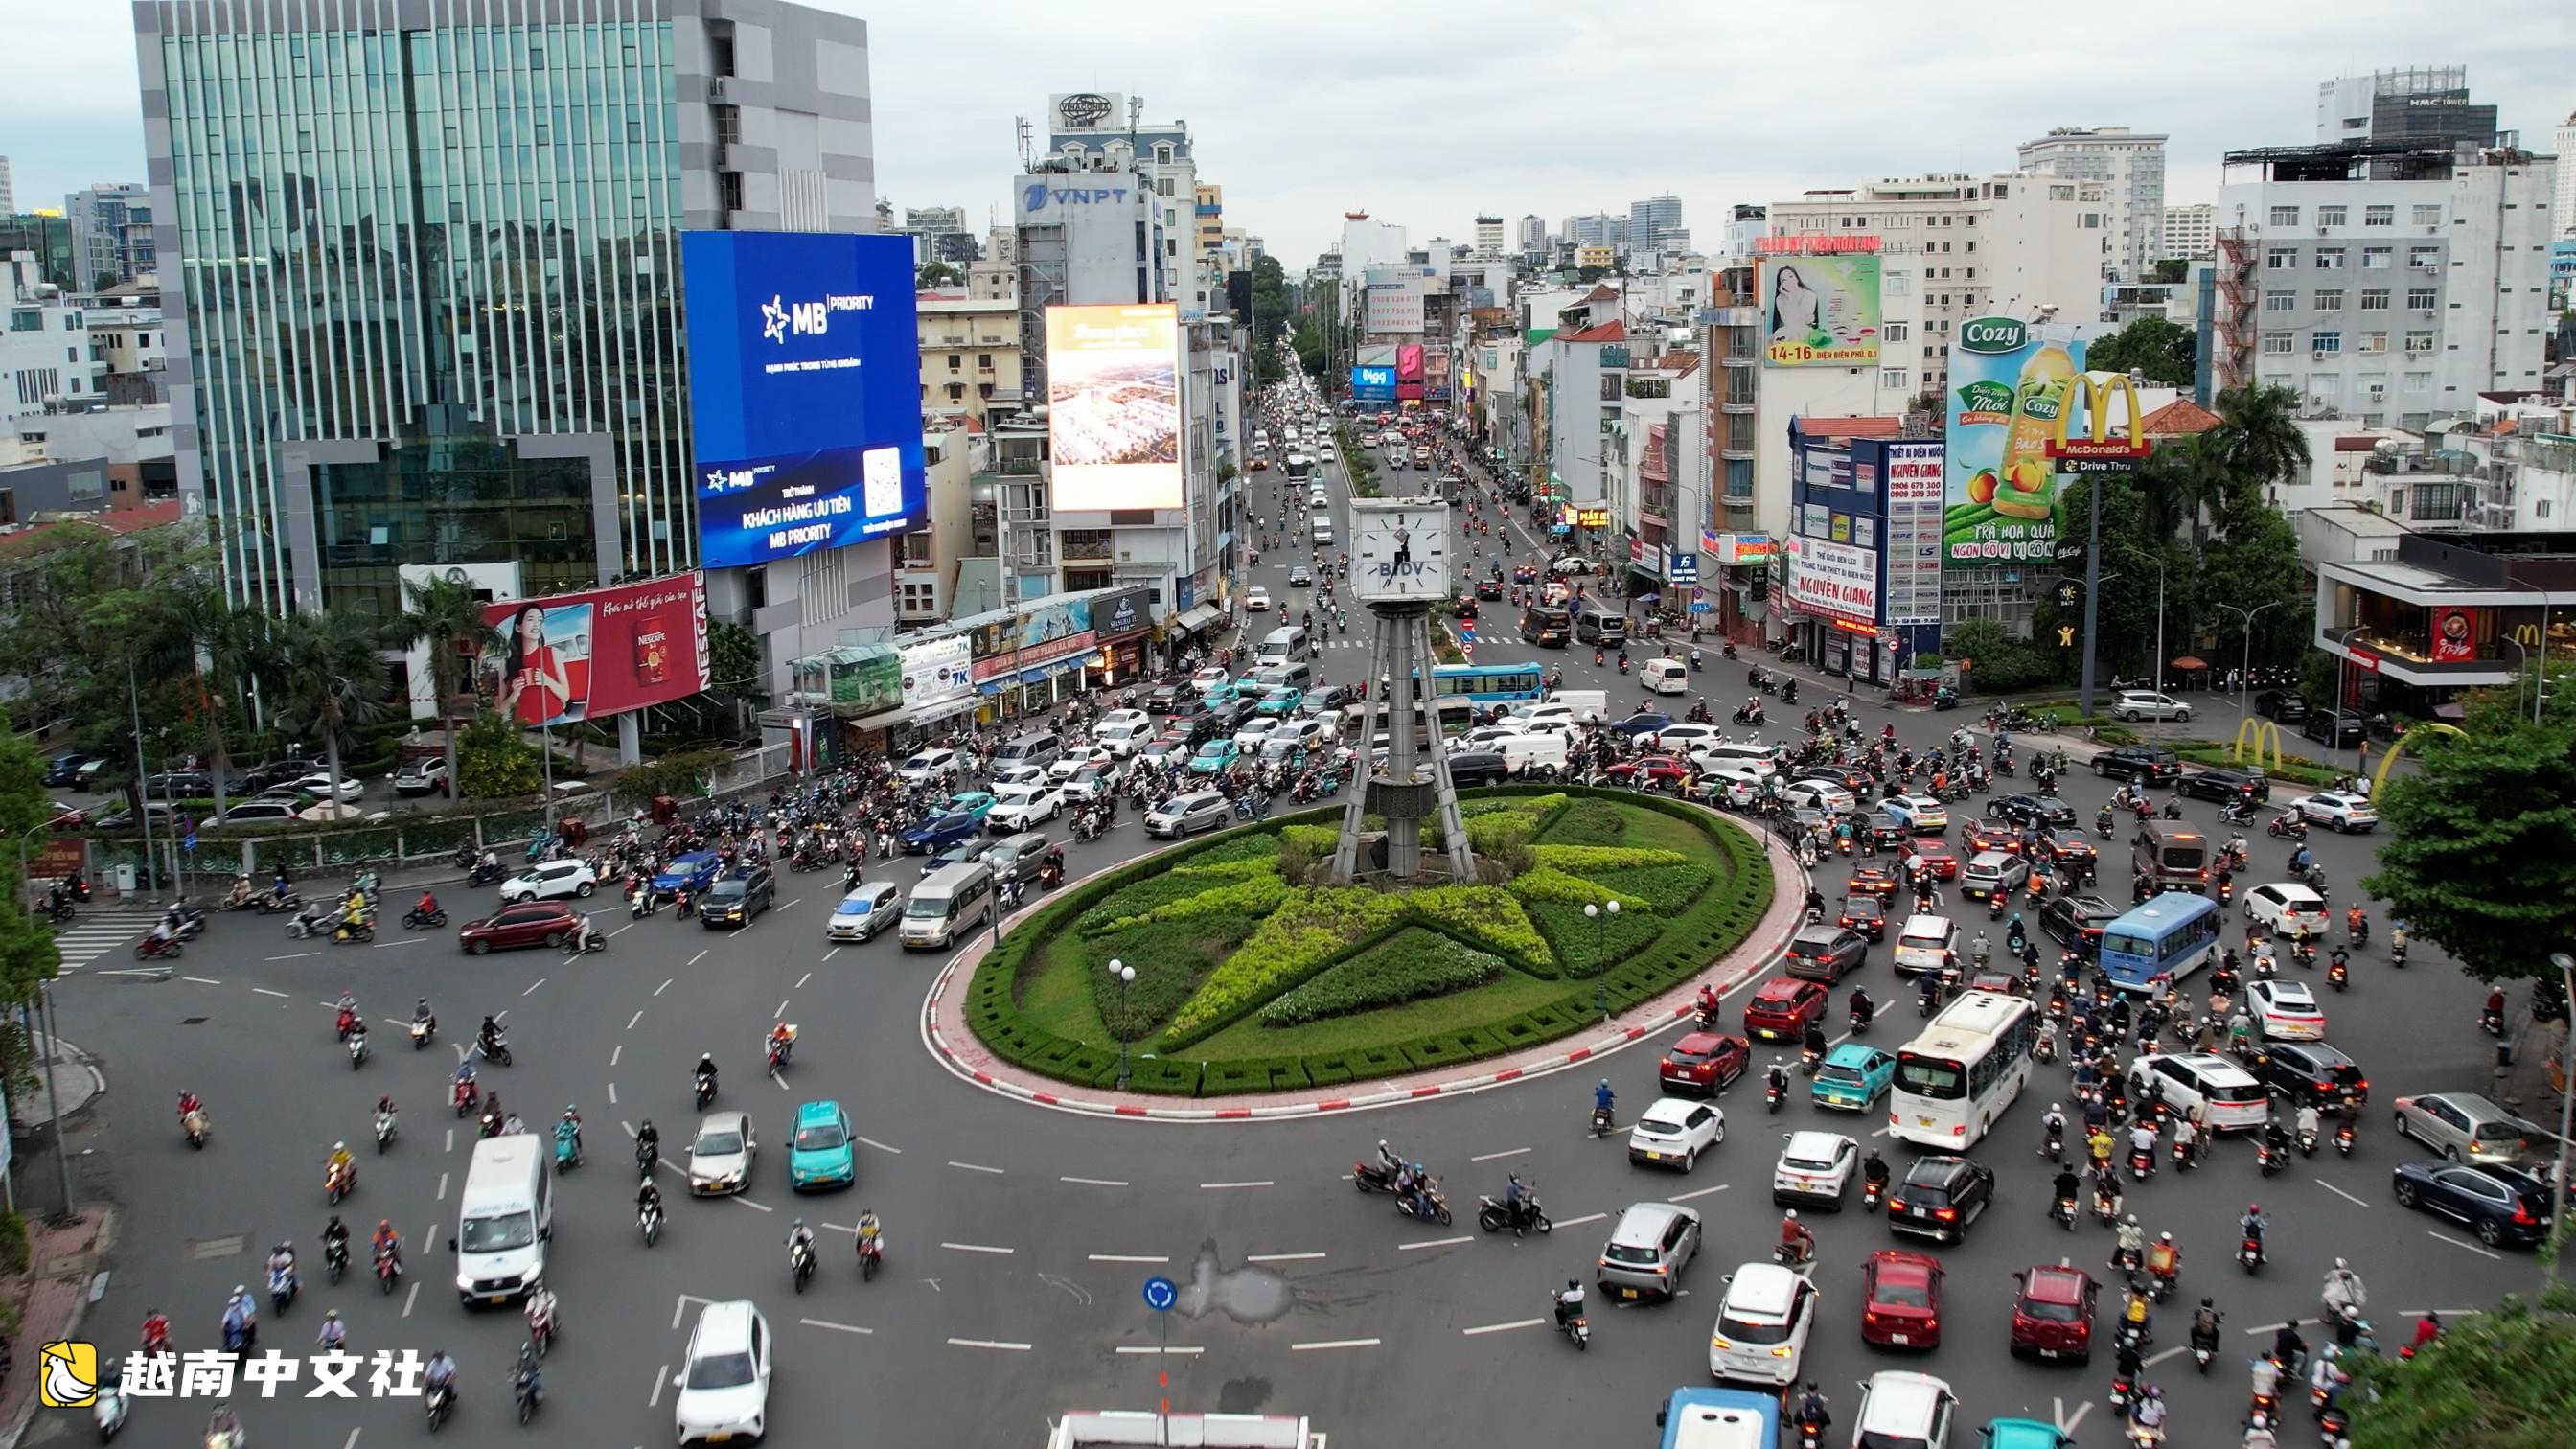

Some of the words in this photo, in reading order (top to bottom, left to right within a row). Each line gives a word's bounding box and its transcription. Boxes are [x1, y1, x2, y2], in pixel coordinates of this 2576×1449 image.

[1061, 103, 1109, 112] VINACONEX
[1054, 189, 1127, 204] VNPT
[793, 302, 828, 335] MB
[830, 295, 874, 311] PRIORITY
[1967, 324, 2019, 346] Cozy
[1771, 346, 1812, 360] 14-16
[2025, 399, 2059, 417] Cozy
[2066, 445, 2131, 454] McDonald's
[1920, 463, 1942, 478] GIANG
[2080, 461, 2107, 471] Drive
[2110, 461, 2131, 470] Thru
[729, 470, 754, 487] MB
[743, 508, 782, 529] KHÁCH
[782, 504, 813, 522] HÀNG
[830, 495, 851, 514] TIÊN
[770, 533, 786, 549] MB
[788, 523, 832, 546] PRIORITY
[1974, 523, 1996, 539] TRÀ
[2001, 525, 2024, 539] HOA
[2030, 518, 2055, 538] QUẢ
[1919, 547, 1936, 556] LS
[1953, 544, 1979, 557] NGON
[1380, 562, 1425, 576] BIDV
[1842, 586, 1873, 607] GIANG
[952, 669, 968, 686] 7K
